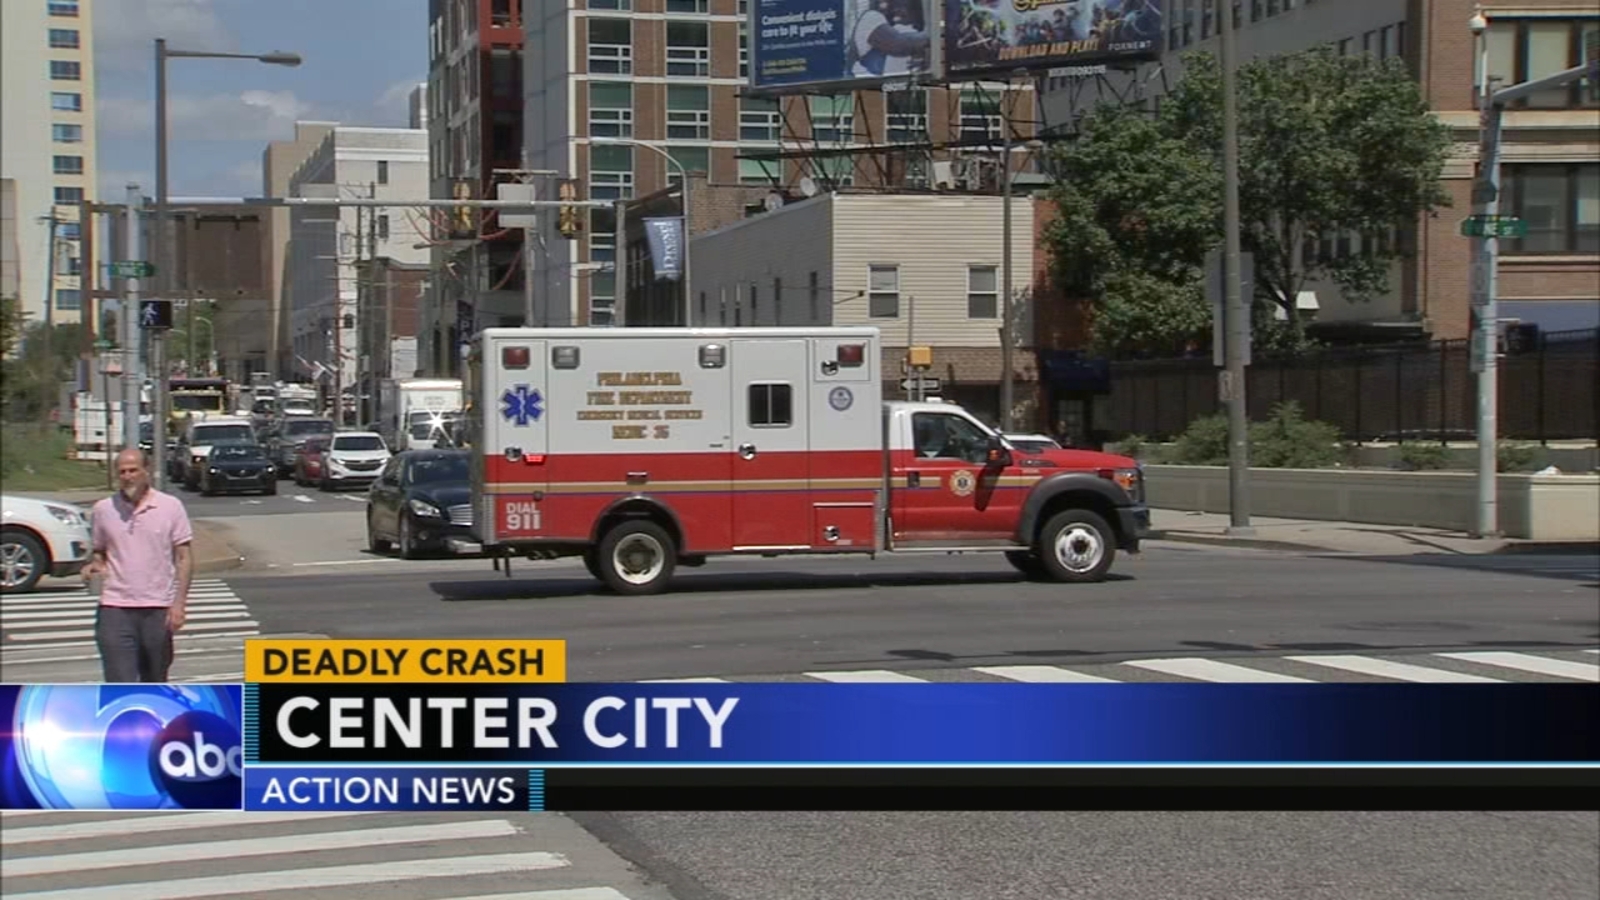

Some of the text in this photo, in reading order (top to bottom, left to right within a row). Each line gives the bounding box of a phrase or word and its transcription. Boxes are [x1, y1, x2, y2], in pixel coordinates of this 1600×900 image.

[998, 42, 1049, 60] DOWNLOAD
[1050, 41, 1071, 56] AND
[597, 371, 682, 386] PHILADELPHIA
[586, 390, 692, 405] FIRE DEPARTMENT
[506, 502, 541, 514] DIAL
[507, 514, 541, 530] 911
